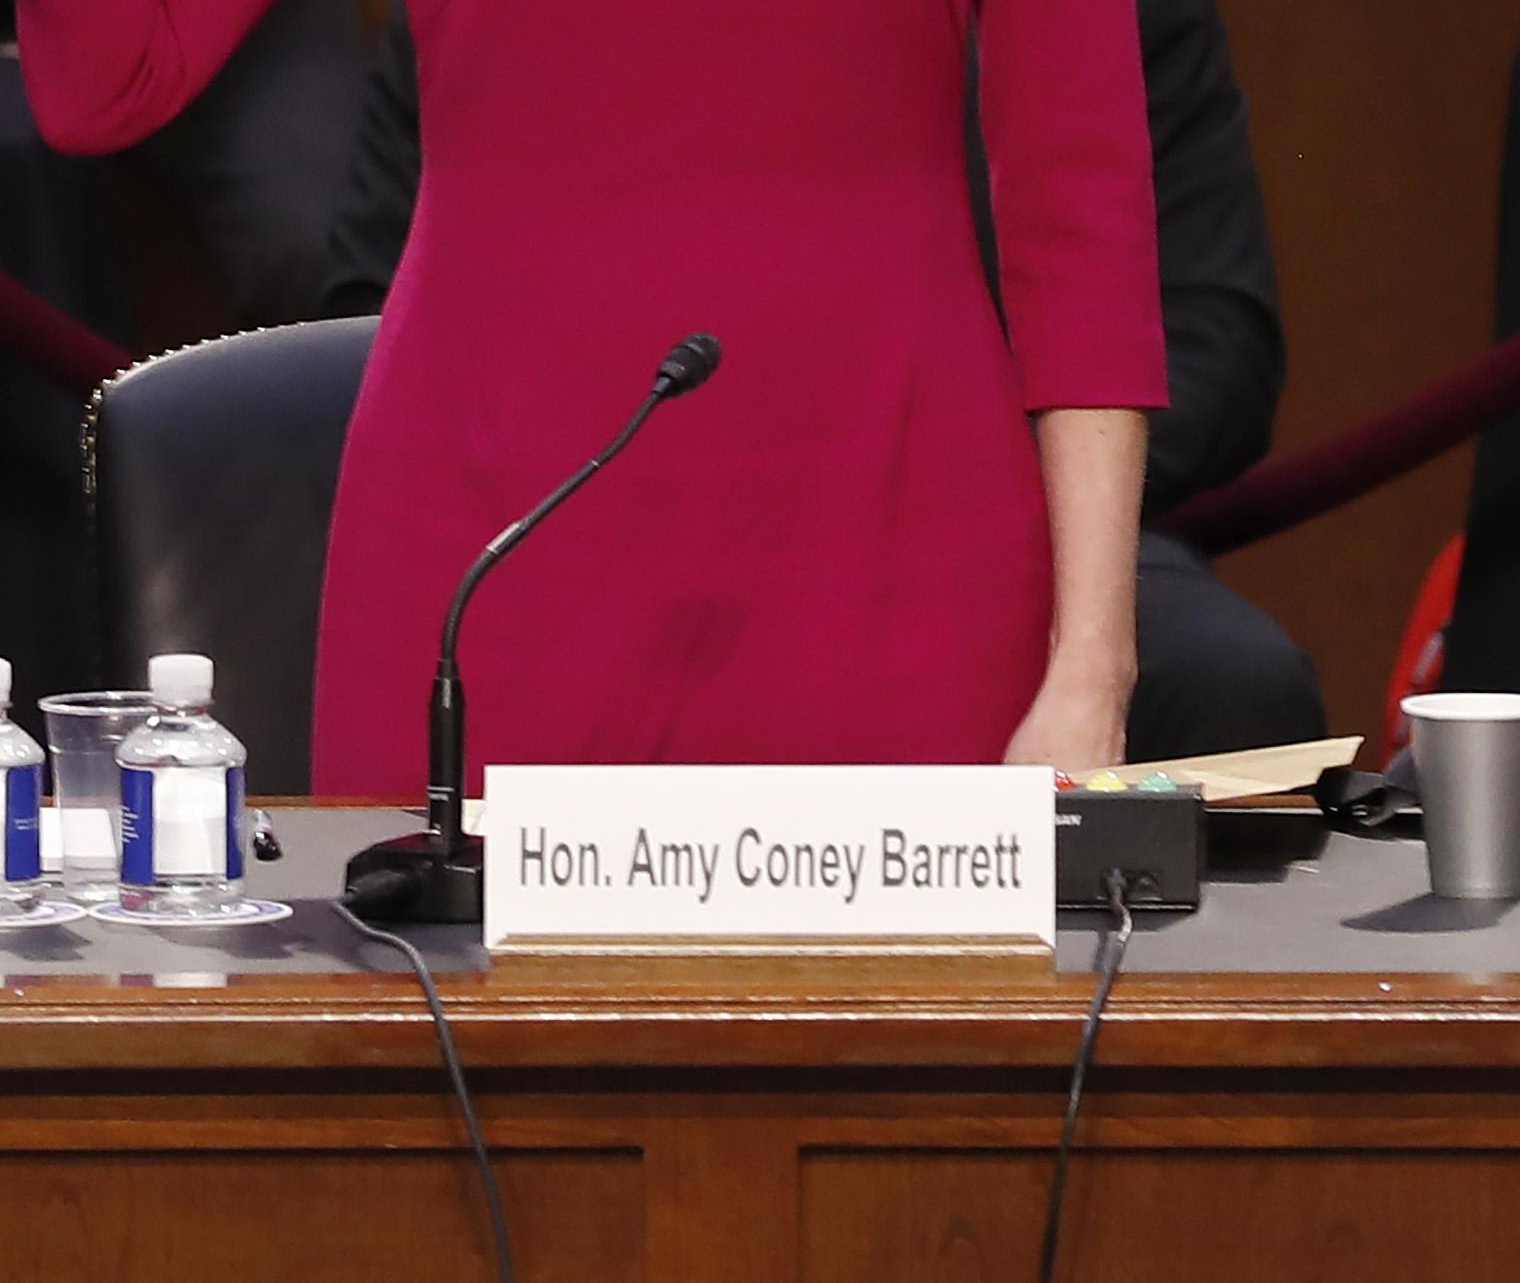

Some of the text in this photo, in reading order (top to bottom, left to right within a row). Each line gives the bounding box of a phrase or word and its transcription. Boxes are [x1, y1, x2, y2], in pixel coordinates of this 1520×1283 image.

[520, 826, 1021, 905] Hon. Amy Coney Barrett
